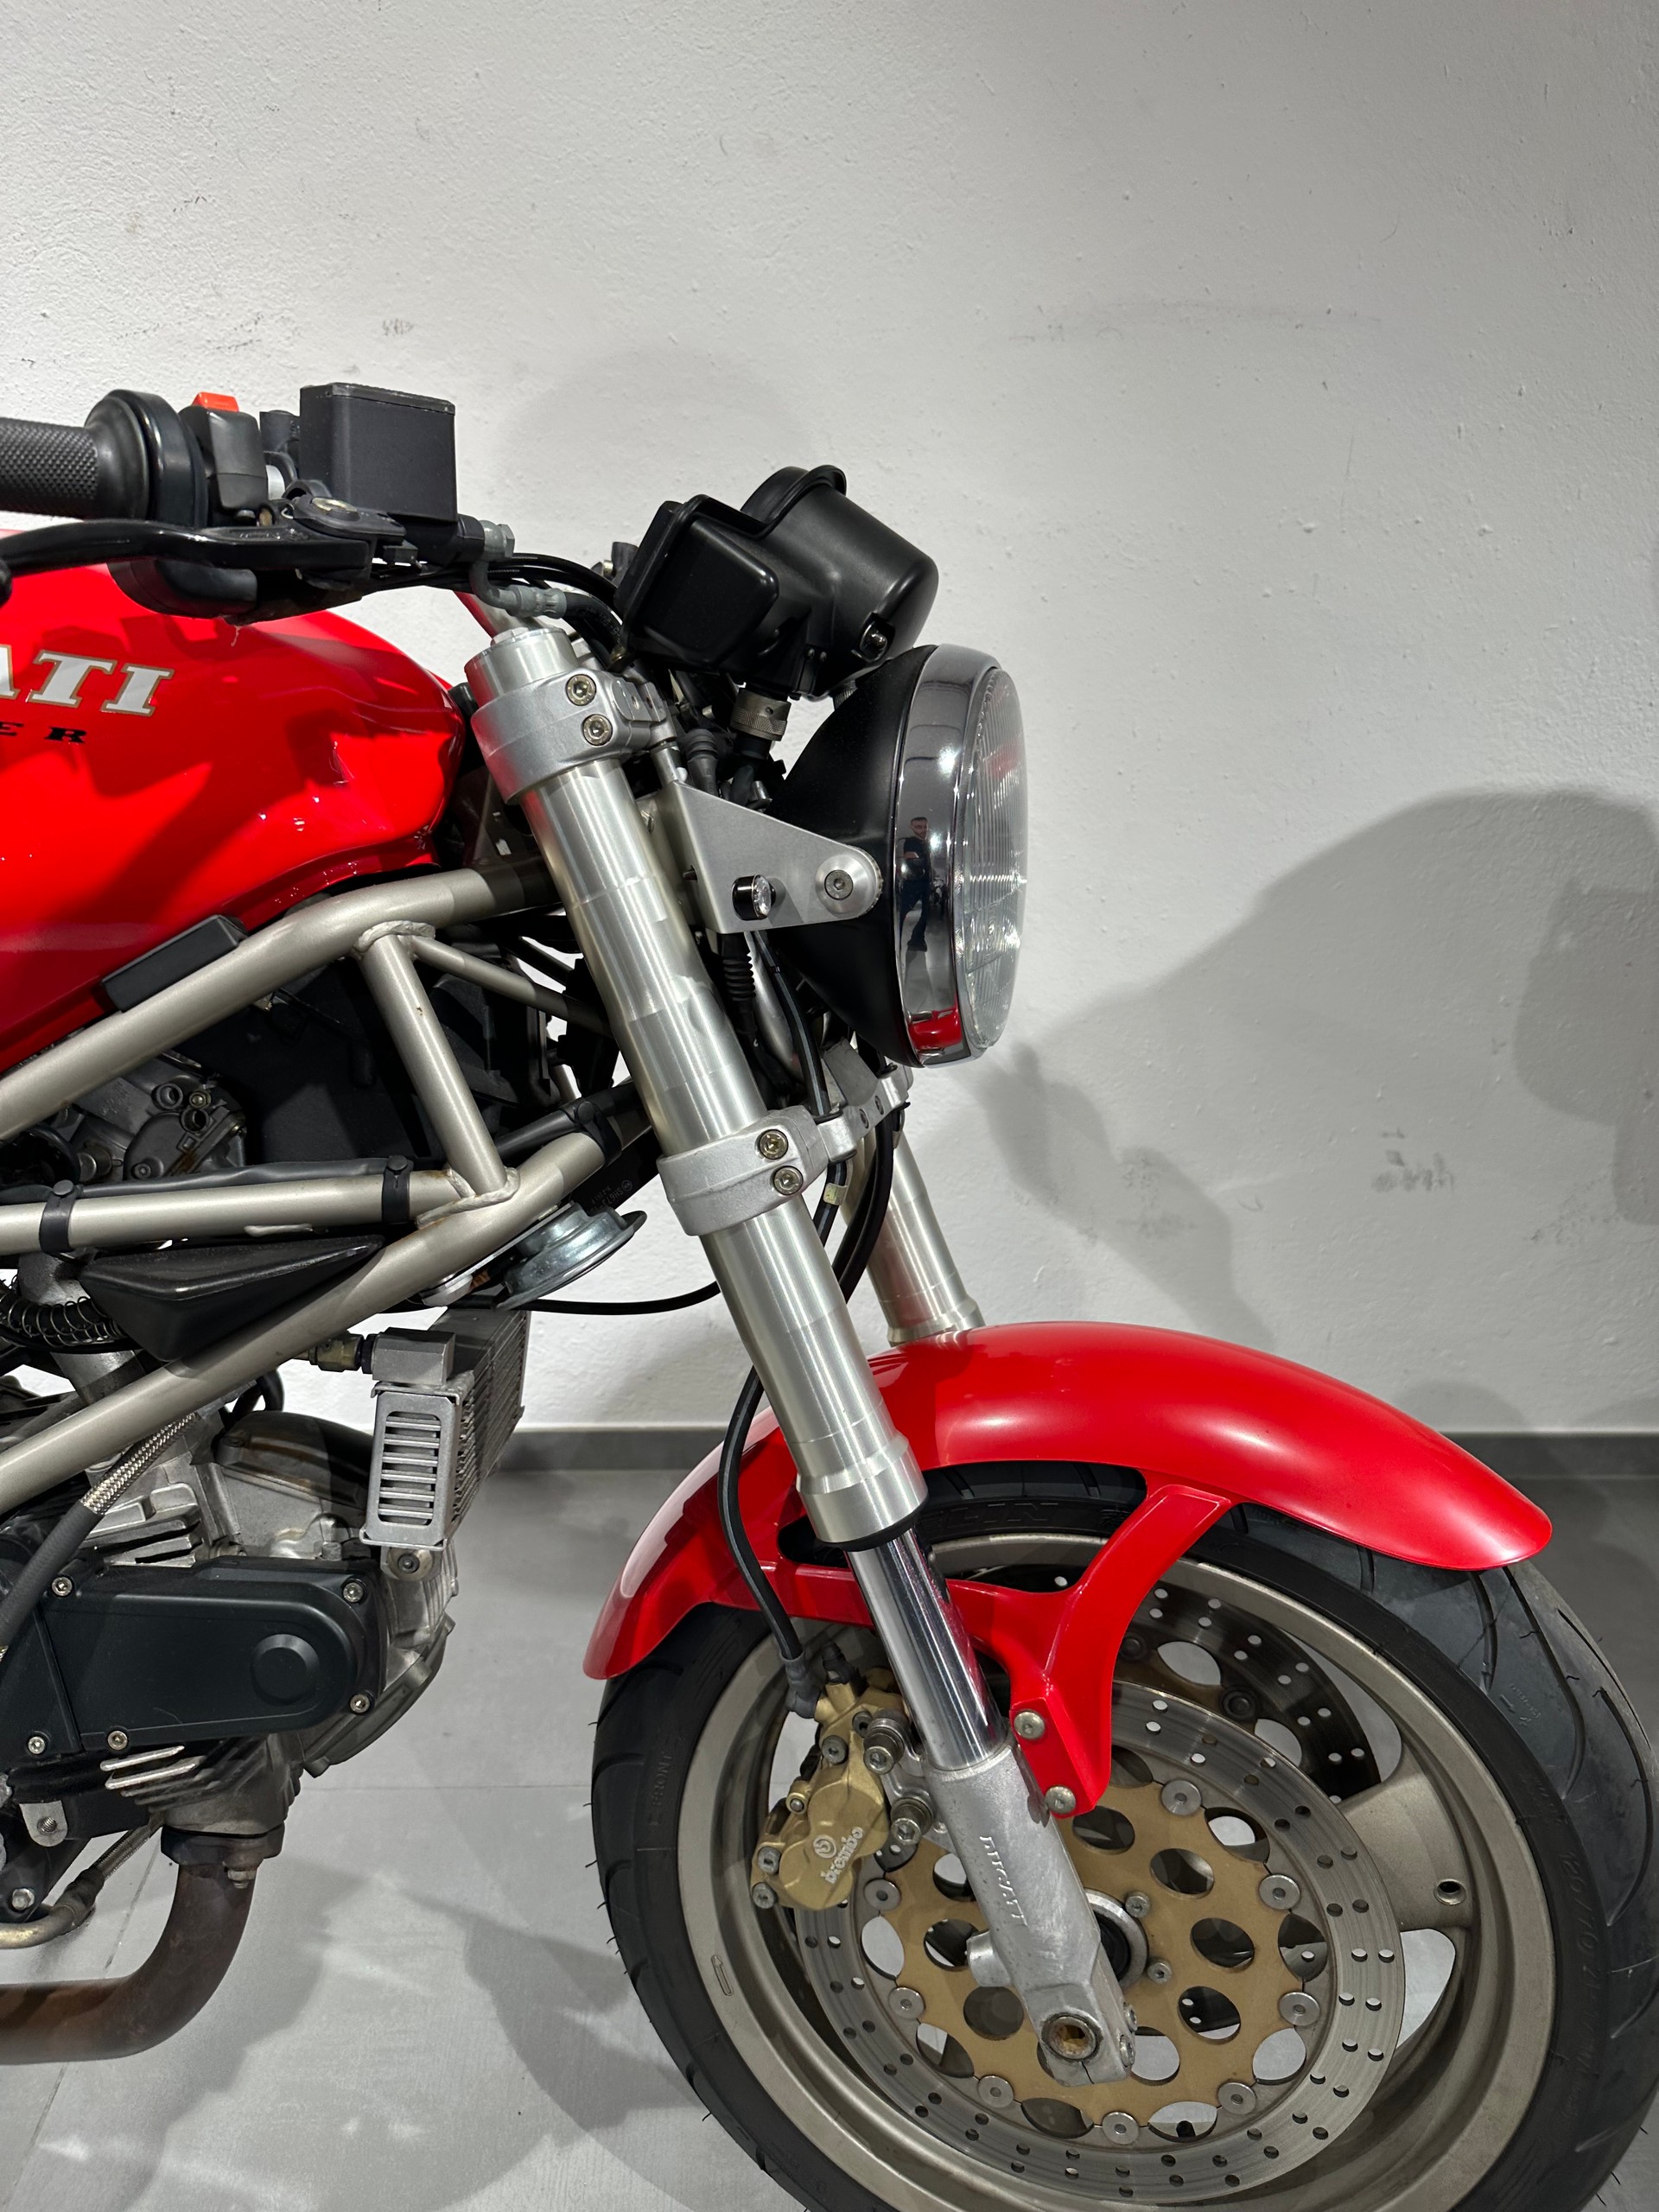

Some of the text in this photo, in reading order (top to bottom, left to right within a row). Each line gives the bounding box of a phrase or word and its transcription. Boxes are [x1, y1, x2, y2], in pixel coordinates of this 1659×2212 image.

[0, 644, 175, 718] TI
[819, 1826, 864, 1885] brembo
[979, 1835, 1029, 1927] DUCATI
